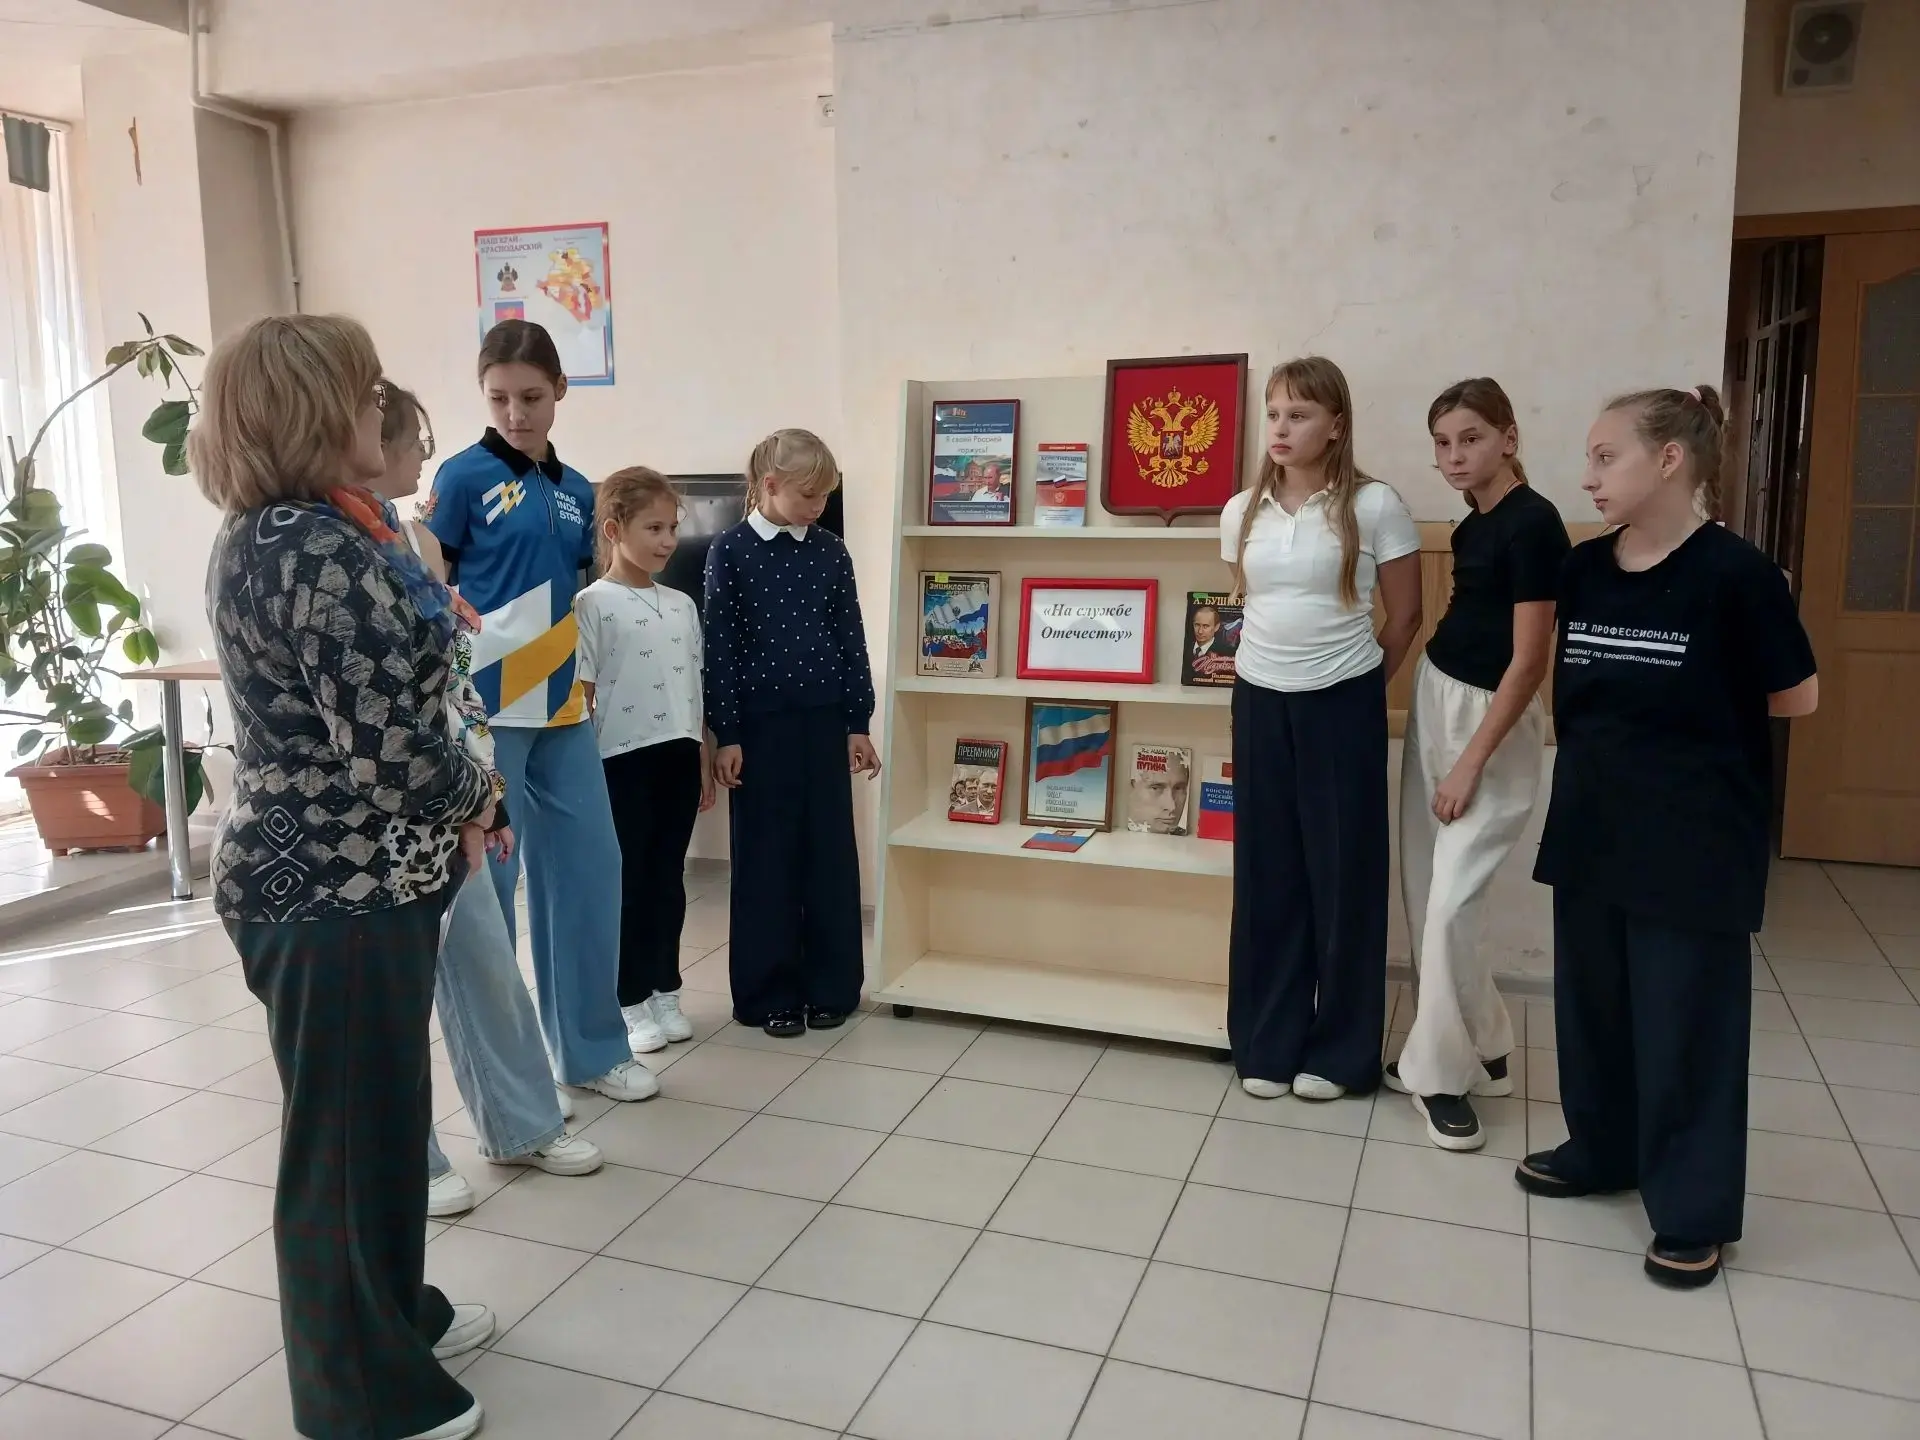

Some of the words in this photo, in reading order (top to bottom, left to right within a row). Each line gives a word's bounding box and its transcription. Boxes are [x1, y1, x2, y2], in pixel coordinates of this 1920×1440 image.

[553, 489, 576, 506] KRAS
[1043, 603, 1073, 617] «На
[1076, 603, 1133, 620] службе
[1041, 626, 1133, 643] Отечеству»
[1591, 624, 1690, 643] ПРОФЕССИОНАЛЫ
[957, 745, 1000, 759] ПРЕЕМНИКИ
[1136, 761, 1167, 772] ПУТИНА
